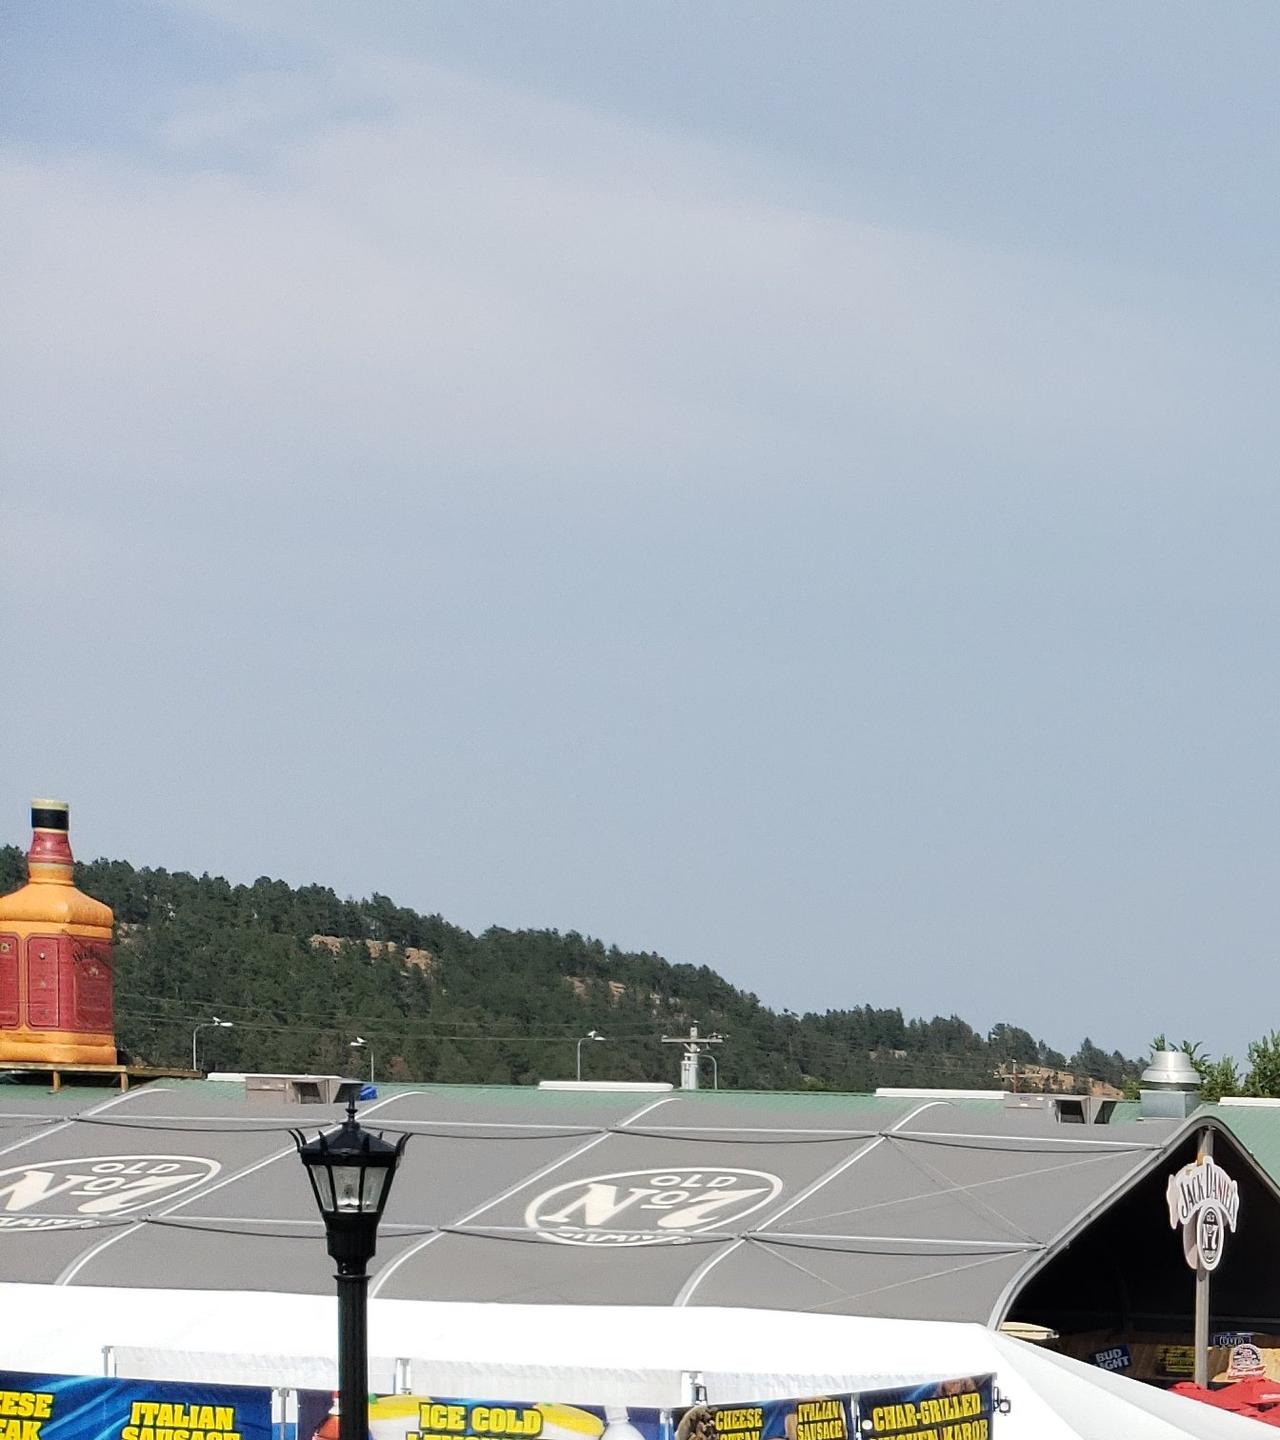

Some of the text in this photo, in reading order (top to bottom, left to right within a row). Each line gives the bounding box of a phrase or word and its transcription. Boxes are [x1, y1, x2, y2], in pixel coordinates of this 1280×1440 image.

[91, 1162, 181, 1174] OLD
[649, 1174, 738, 1188] OLD
[1095, 1348, 1122, 1363] BUD
[130, 1401, 235, 1431] ITALIAN
[418, 1403, 543, 1436] ICE COLD
[714, 1407, 763, 1431] CHEESE
[796, 1401, 842, 1423] ITALIAN
[872, 1392, 982, 1431] CHAR-GRILLED
